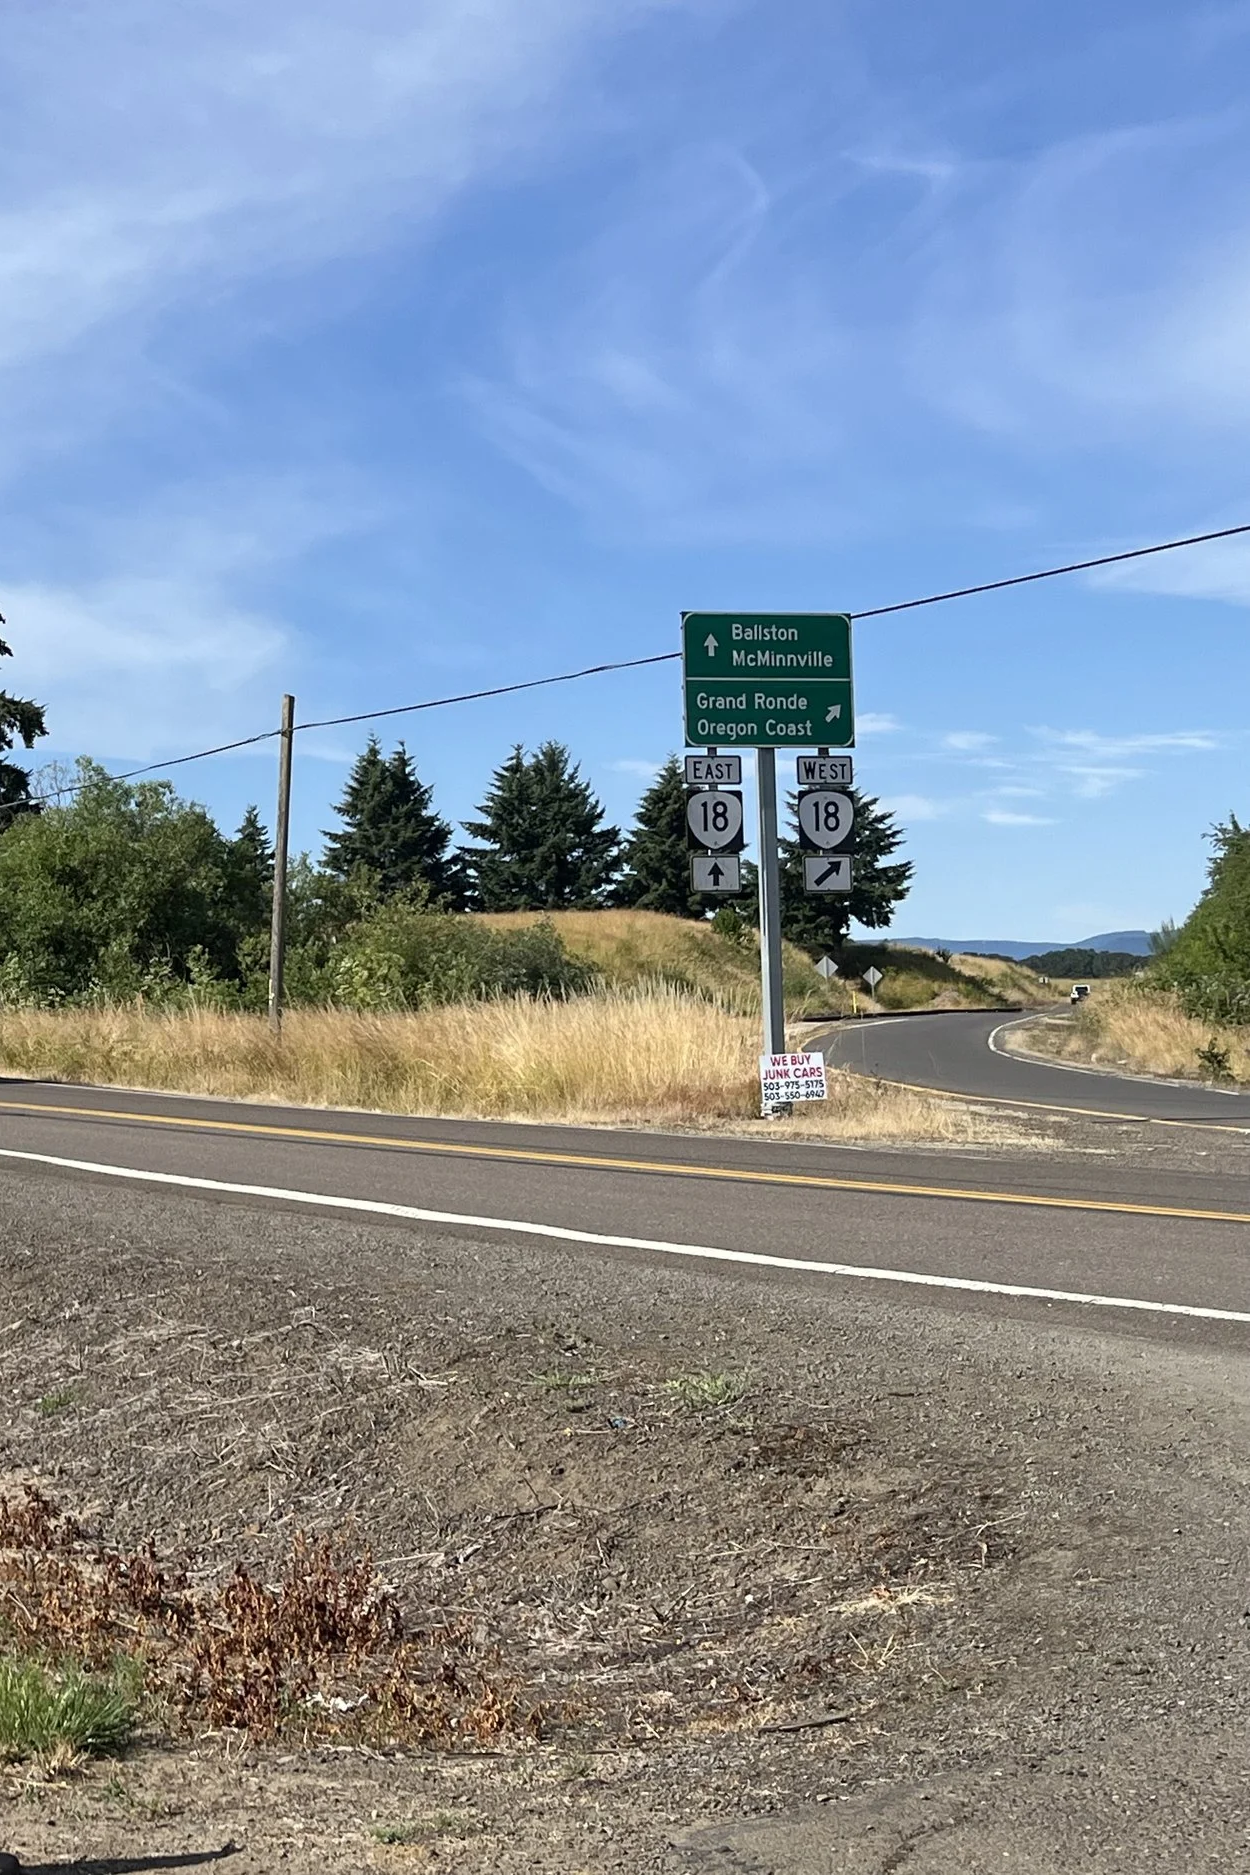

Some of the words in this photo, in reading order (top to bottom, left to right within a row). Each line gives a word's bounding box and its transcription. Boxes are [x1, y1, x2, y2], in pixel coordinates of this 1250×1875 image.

[732, 624, 798, 640] Ballston
[732, 650, 833, 667] McMinnville
[696, 692, 746, 709] Grand
[754, 693, 808, 709] Ronde
[697, 719, 757, 740] Oregon
[765, 719, 812, 736] Coast
[693, 761, 733, 779] EAST
[803, 761, 847, 780] WEST
[700, 801, 728, 832] 18
[812, 801, 840, 832] 18
[770, 1055, 788, 1067] WE
[791, 1054, 811, 1066] BUY
[763, 1068, 791, 1081] JUNK
[793, 1067, 823, 1078] CARS
[763, 1079, 824, 1091] 503-975-5175
